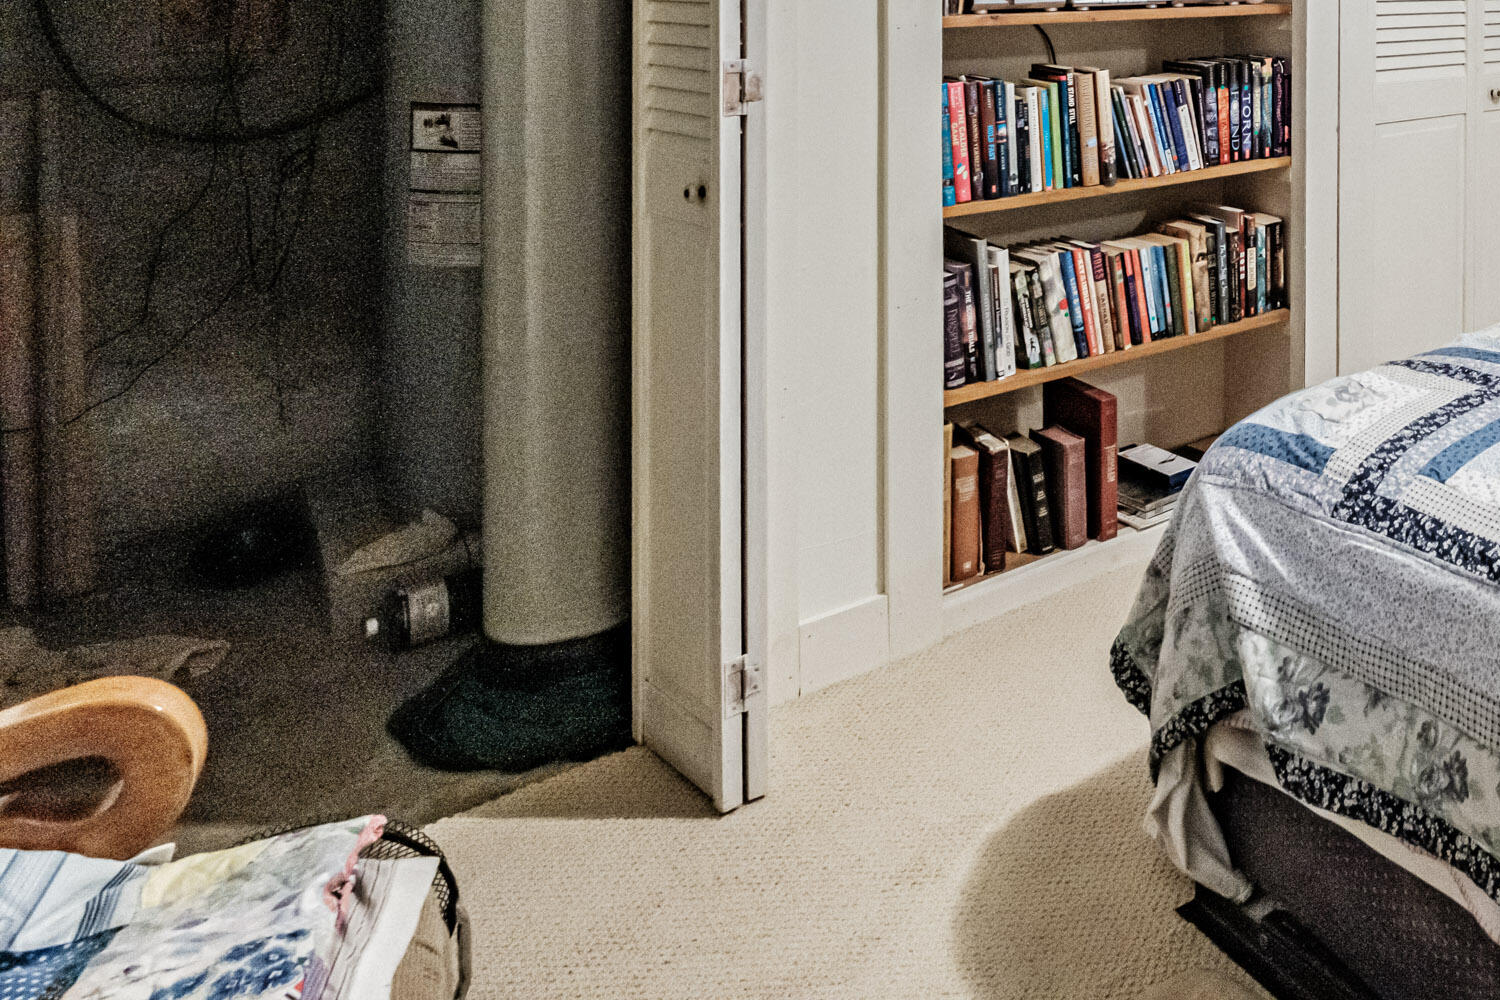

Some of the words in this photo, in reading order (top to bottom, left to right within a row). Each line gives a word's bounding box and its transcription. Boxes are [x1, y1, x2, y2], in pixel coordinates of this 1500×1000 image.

[1067, 87, 1076, 106] STAND
[958, 109, 966, 125] THE
[1068, 108, 1077, 125] STILL
[1241, 92, 1252, 145] TORN
[951, 122, 959, 146] GAME
[959, 126, 968, 157] CALDER
[1093, 252, 1104, 280] HOLES
